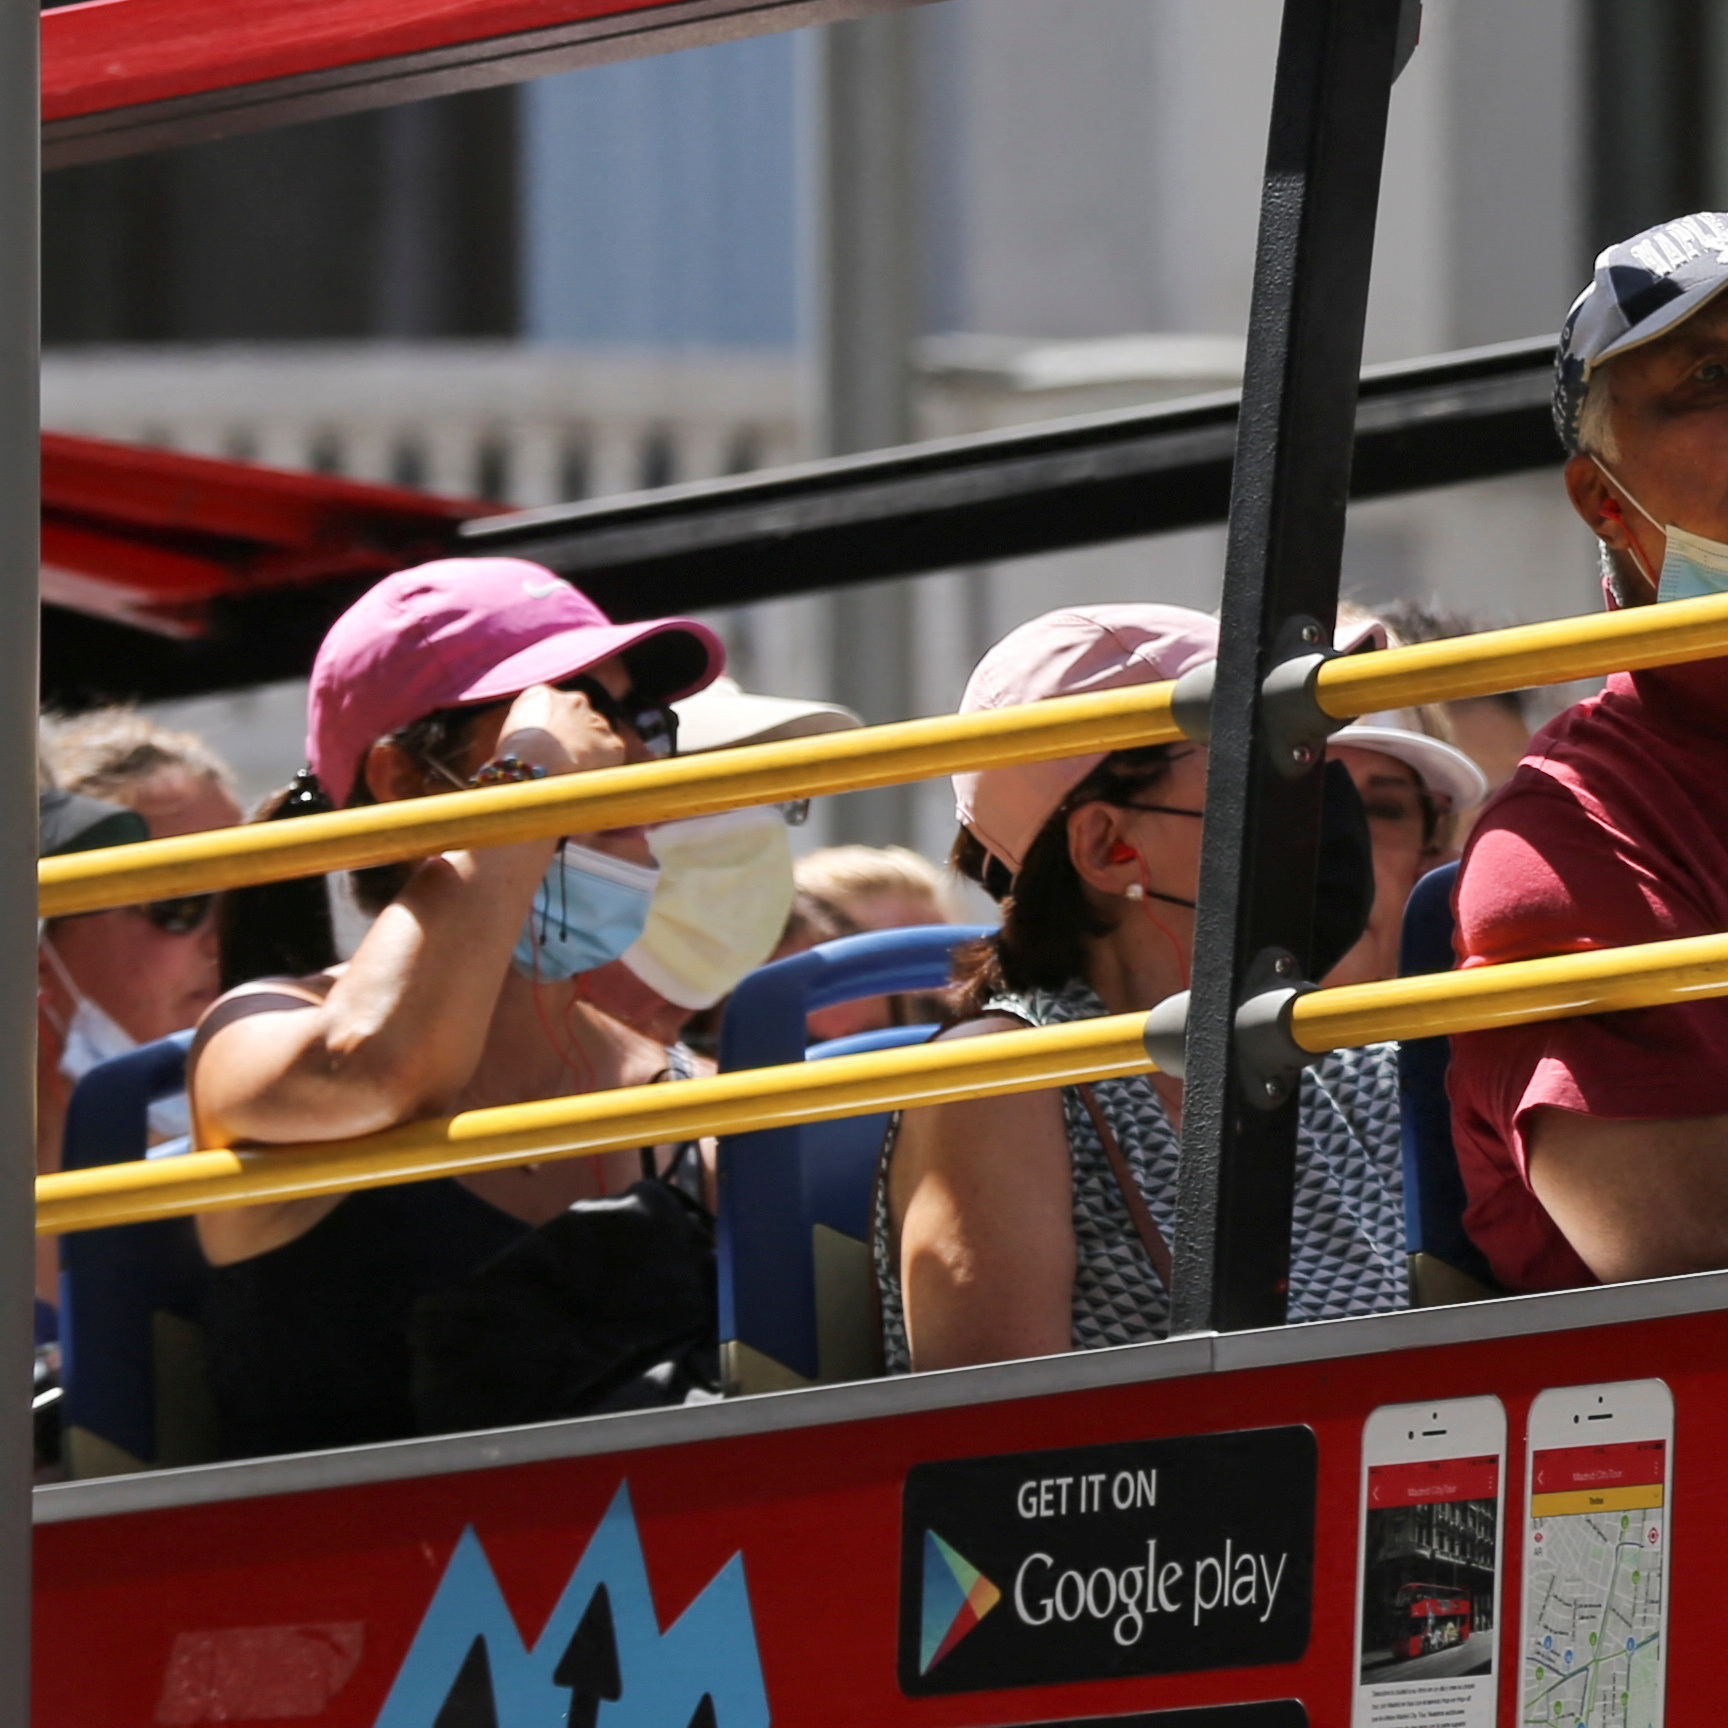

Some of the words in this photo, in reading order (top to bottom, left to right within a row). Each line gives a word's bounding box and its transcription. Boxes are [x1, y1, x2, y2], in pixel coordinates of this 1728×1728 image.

[1630, 210, 1726, 277] MAPLE
[1016, 1476, 1074, 1520] GET
[1079, 1473, 1107, 1514] IT
[1111, 1468, 1157, 1511] ON
[1013, 1538, 1184, 1647] Google
[1193, 1537, 1288, 1627] play
